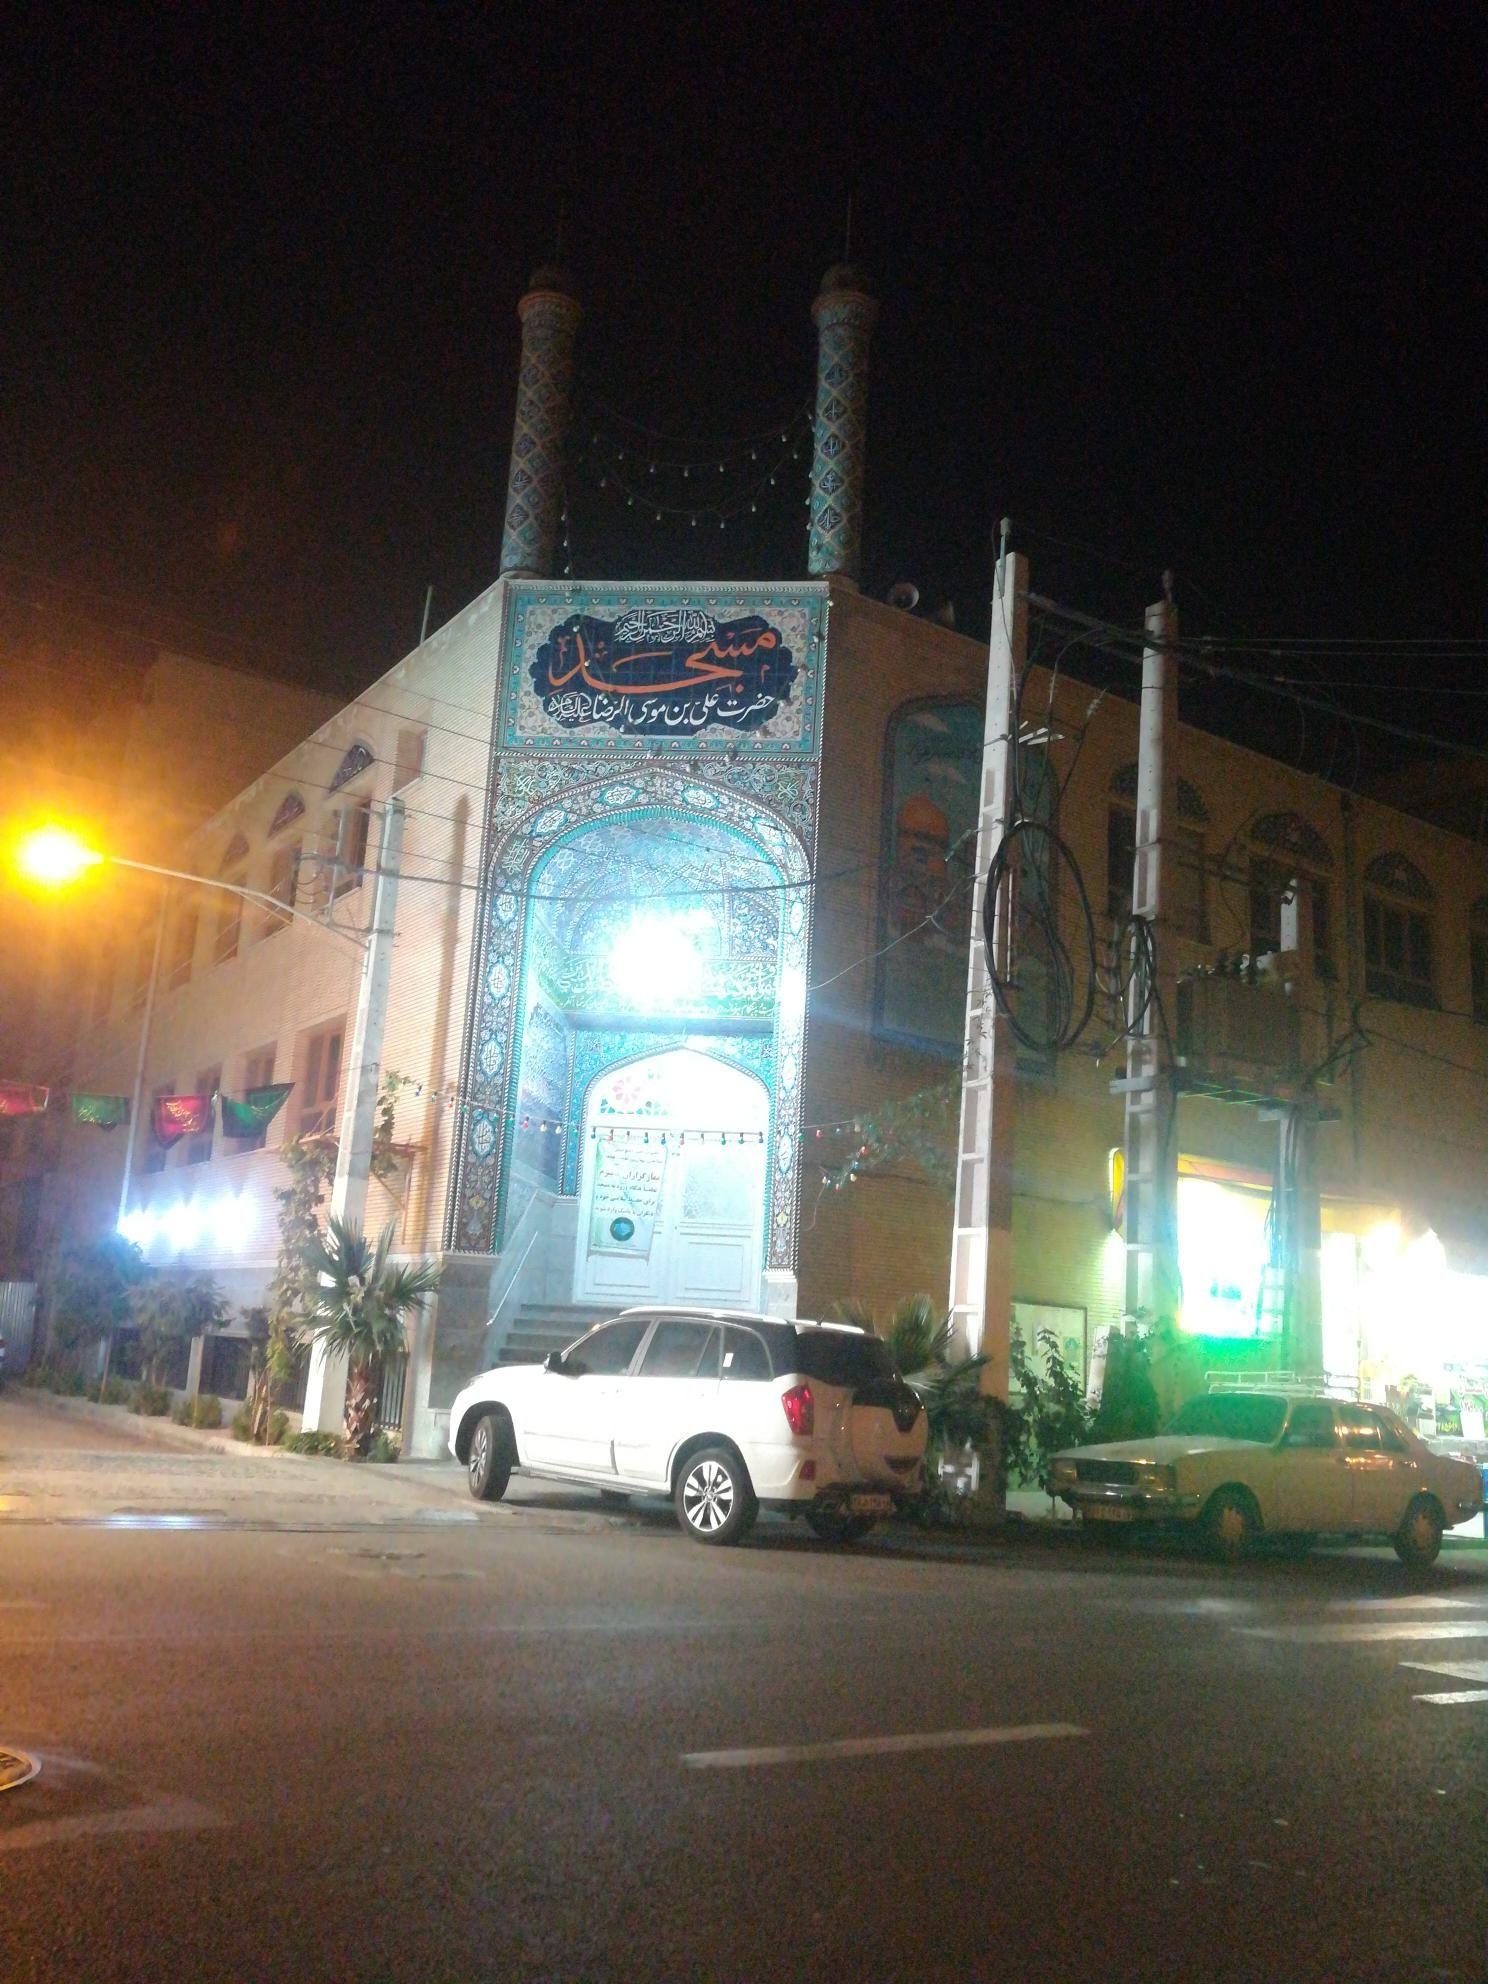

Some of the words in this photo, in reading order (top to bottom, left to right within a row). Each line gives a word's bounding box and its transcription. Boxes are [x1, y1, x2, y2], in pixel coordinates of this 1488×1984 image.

[548, 628, 777, 694] مسجد
[592, 694, 630, 722] الرضا
[664, 698, 689, 726] بن
[716, 694, 776, 723] حضرت
